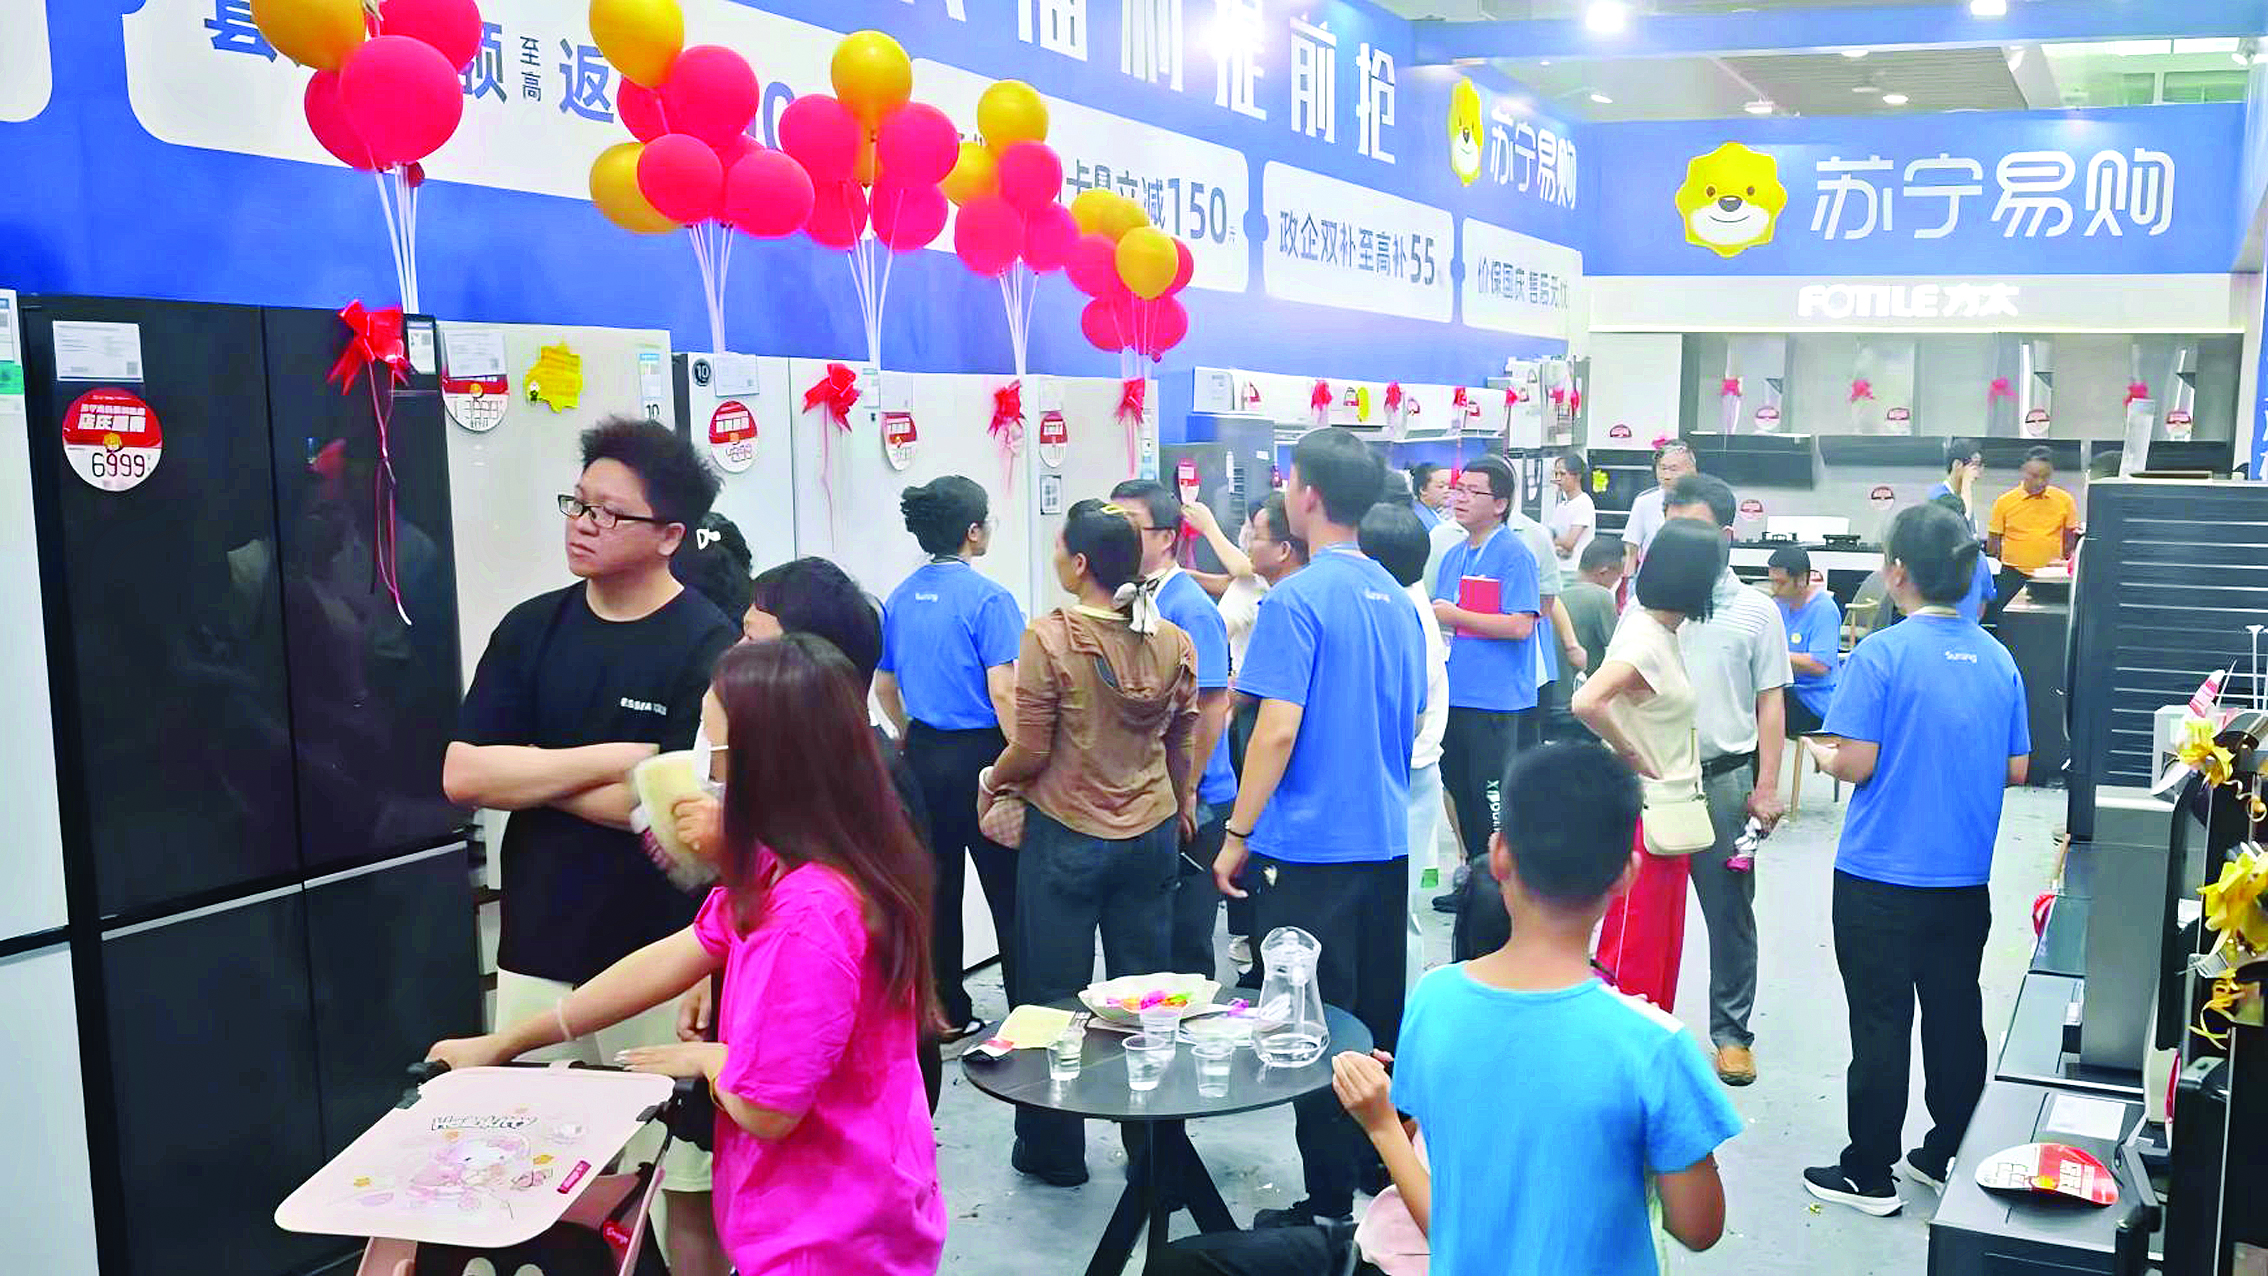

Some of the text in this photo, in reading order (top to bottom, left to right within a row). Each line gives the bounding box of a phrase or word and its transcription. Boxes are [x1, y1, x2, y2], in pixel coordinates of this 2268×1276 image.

[1490, 106, 1577, 210] 苏宁易购
[1810, 147, 2175, 240] 苏宁易购
[1798, 284, 1939, 319] FOTILE
[92, 452, 145, 478] 6999
